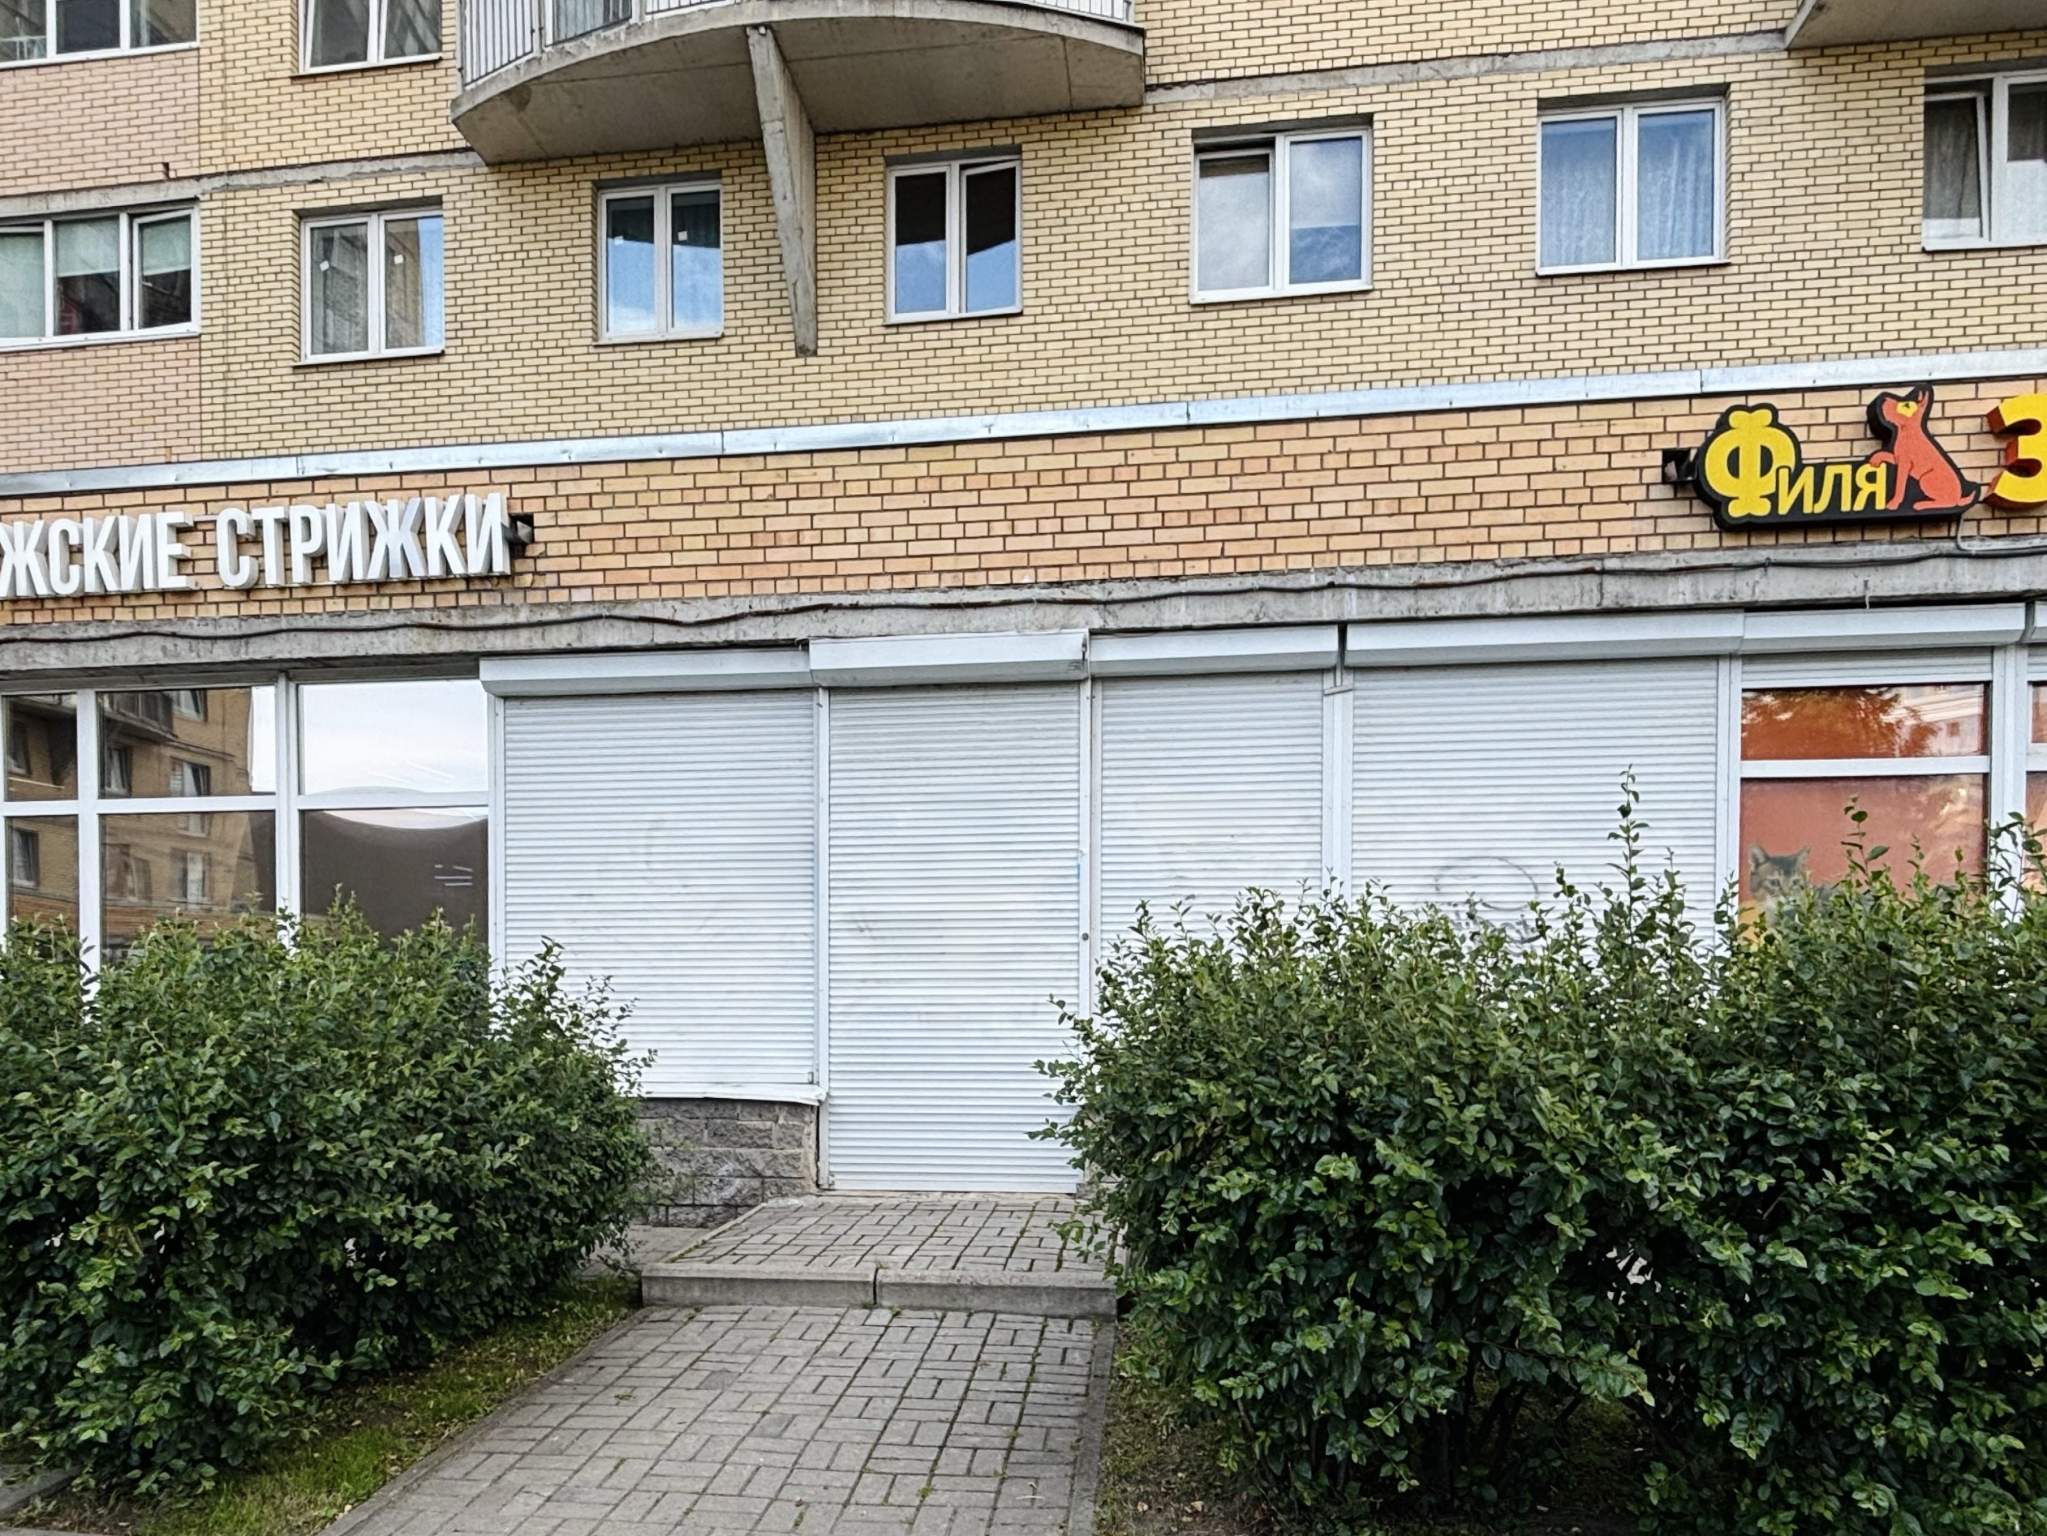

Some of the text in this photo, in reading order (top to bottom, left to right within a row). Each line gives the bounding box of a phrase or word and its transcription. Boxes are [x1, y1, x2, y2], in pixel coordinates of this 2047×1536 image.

[1704, 408, 1888, 517] Филя
[0, 492, 510, 598] ЖСКИЕ СТРИЖКИ
